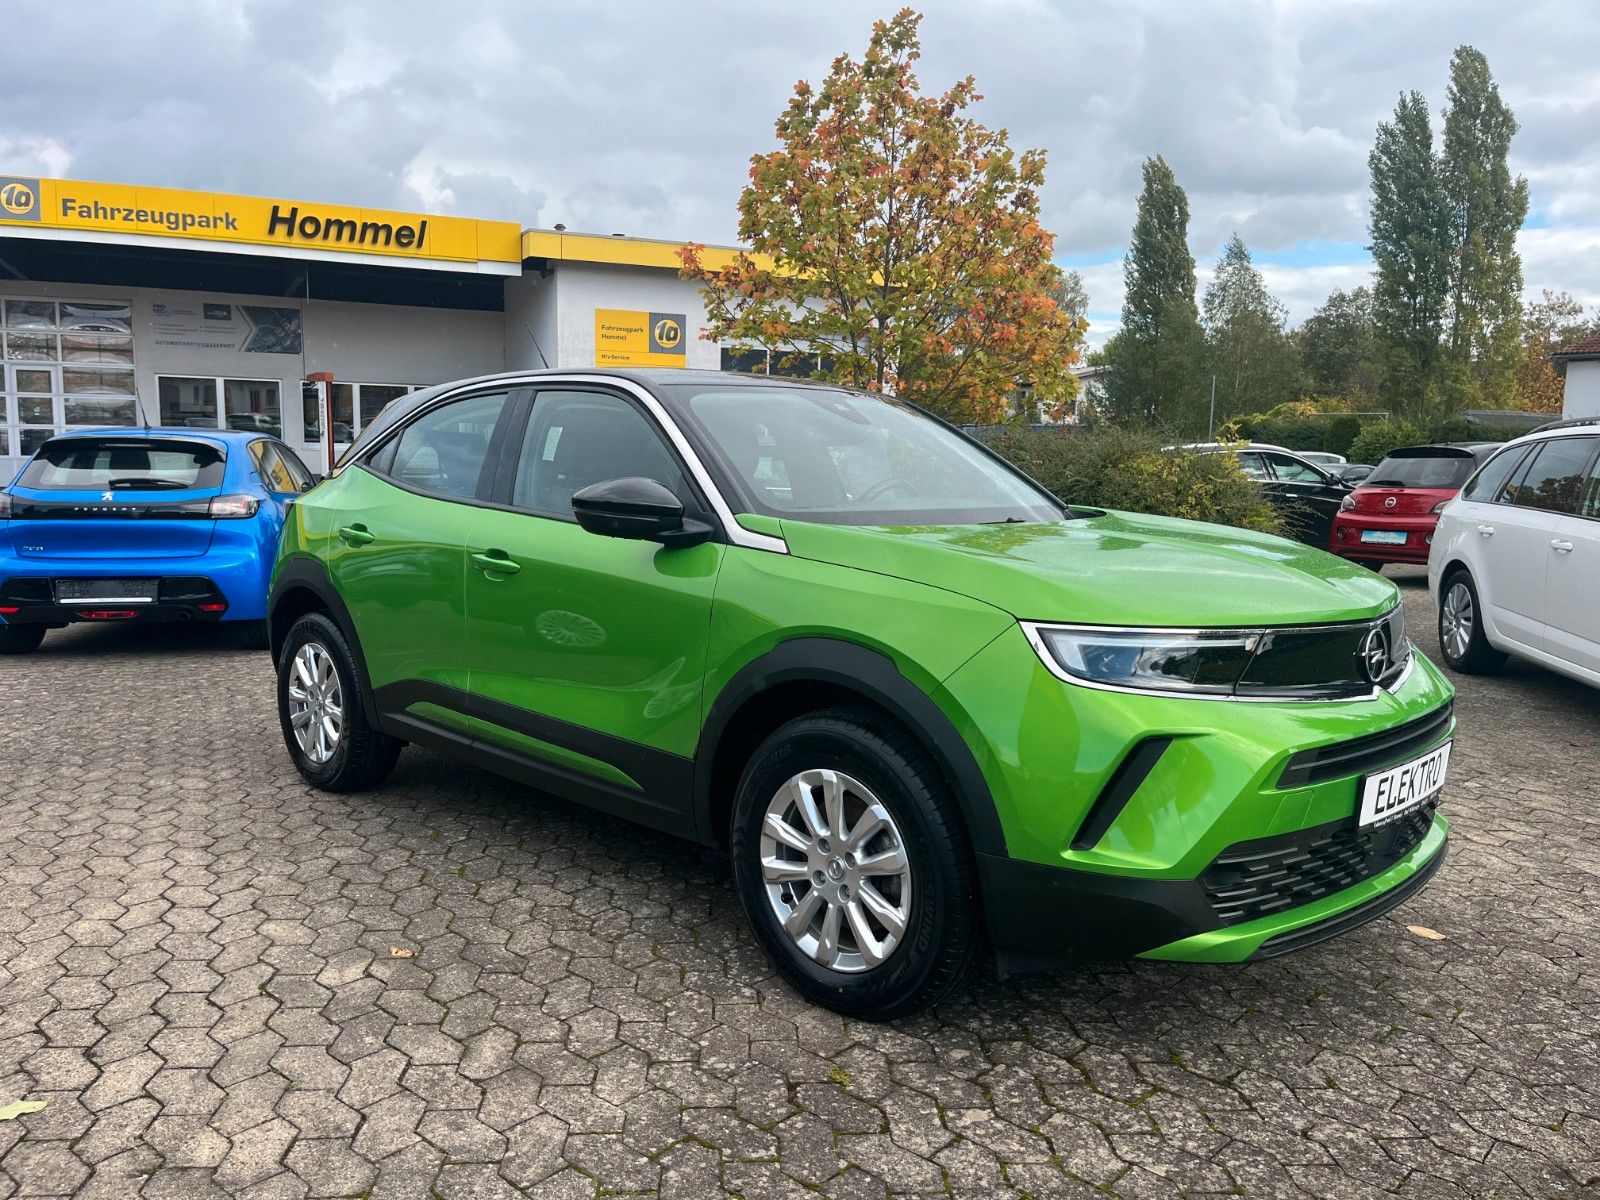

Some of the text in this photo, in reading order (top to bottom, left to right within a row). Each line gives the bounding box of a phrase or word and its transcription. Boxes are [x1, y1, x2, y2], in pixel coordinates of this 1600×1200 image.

[3, 185, 31, 207] 1a
[61, 198, 428, 249] Fahrzeugpark Hommel
[601, 324, 644, 334] Fahrzeugpark
[601, 333, 627, 341] Hommel
[657, 321, 679, 342] 1a
[1374, 752, 1442, 815] ELEKTRO
